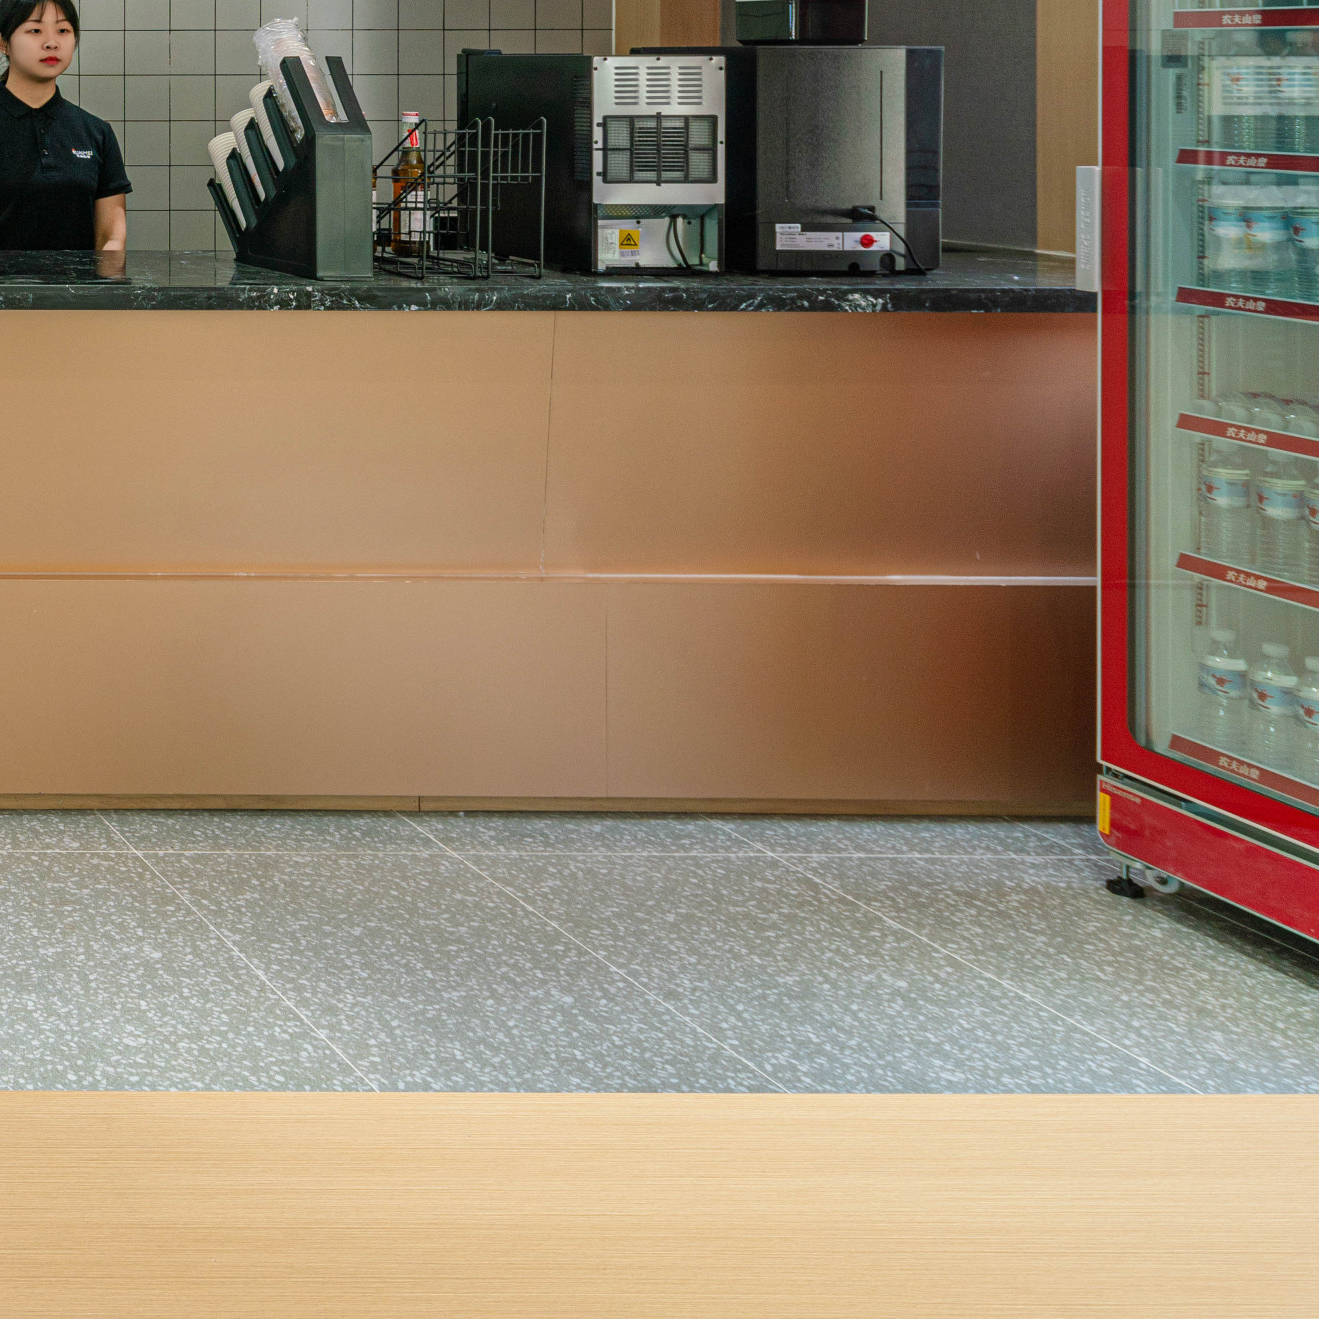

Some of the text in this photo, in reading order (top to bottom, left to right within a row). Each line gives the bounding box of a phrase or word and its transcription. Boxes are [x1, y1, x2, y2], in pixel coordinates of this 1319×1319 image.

[1222, 14, 1262, 25] 农夫山泉
[1226, 155, 1268, 167] 农夫山泉
[1225, 296, 1267, 311] 农夫山泉
[1225, 426, 1268, 444] 农夫山泉
[1225, 570, 1268, 590] 农夫山泉
[1218, 756, 1261, 780] 农夫山泉
